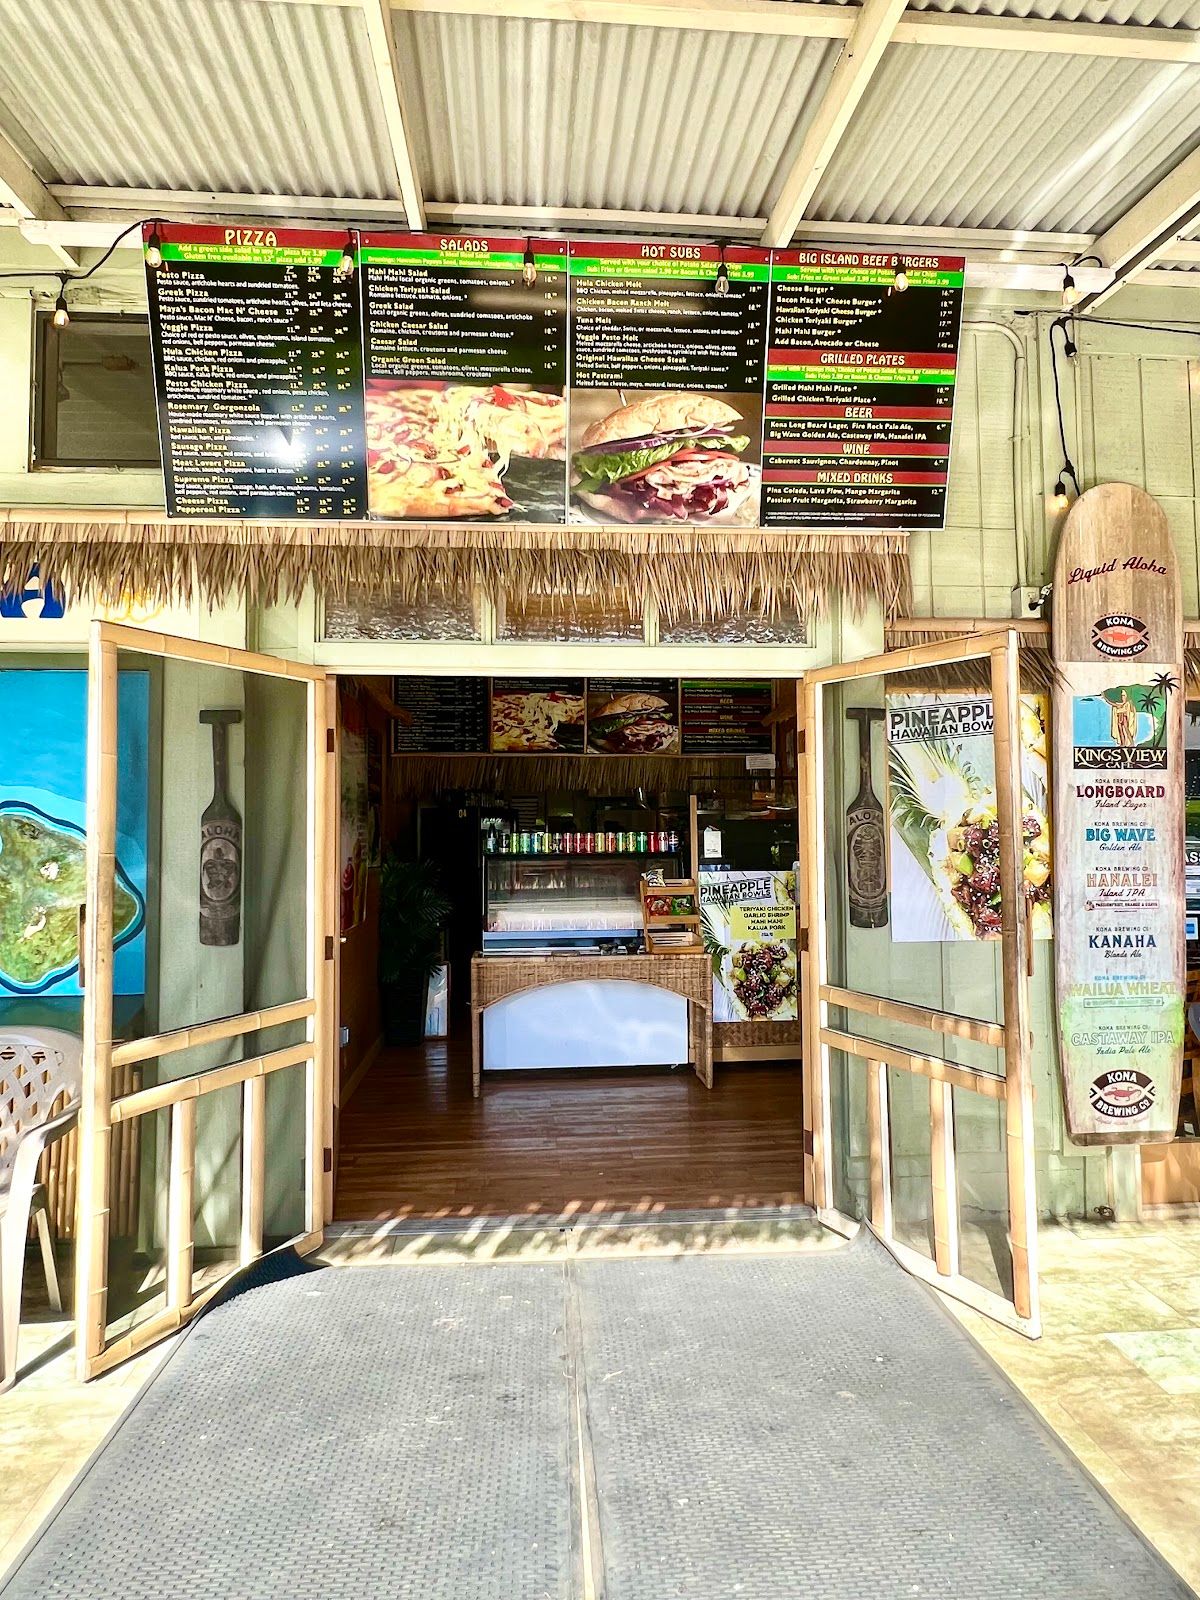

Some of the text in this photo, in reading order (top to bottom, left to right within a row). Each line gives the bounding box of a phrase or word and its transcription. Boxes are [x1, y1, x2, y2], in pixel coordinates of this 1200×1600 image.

[225, 230, 277, 246] PIZZA
[440, 239, 488, 252] SALADS
[641, 245, 700, 258] HOT SUBS
[799, 252, 816, 263] BIG
[821, 253, 858, 265] ISLAND
[862, 255, 888, 266] BEEF
[804, 285, 830, 294] Burger
[790, 338, 813, 346] Bacon,
[821, 353, 904, 365] GRILLED PLATES
[845, 407, 873, 418] BEER
[843, 443, 870, 455] WINE
[817, 472, 893, 484] MIXED DRINKS
[1068, 556, 1167, 584] Liquid Aloha
[1106, 617, 1134, 627] KONA
[891, 704, 993, 730] PINEAPPL
[963, 721, 993, 732] BOW
[1074, 747, 1166, 764] KINGS VIEW
[1076, 785, 1165, 799] LONGBOARD
[1095, 800, 1147, 810] Island Lager
[1085, 828, 1155, 842] BIG WAVE
[1099, 843, 1142, 851] Golden Ale
[1087, 873, 1157, 887] HANALEI
[700, 879, 771, 897] PINEAPPLE
[1099, 889, 1146, 897] Island IPA
[1089, 934, 1157, 948] KANAHA
[1104, 949, 1142, 958] Blonde Ale
[1071, 982, 1176, 996] WAILUA WHEAT
[1071, 1031, 1175, 1046] CASTAWAY IPA
[1096, 1045, 1151, 1055] India Pale Ale
[1106, 1071, 1137, 1083] KONA
[1095, 1101, 1138, 1117] BREWING
